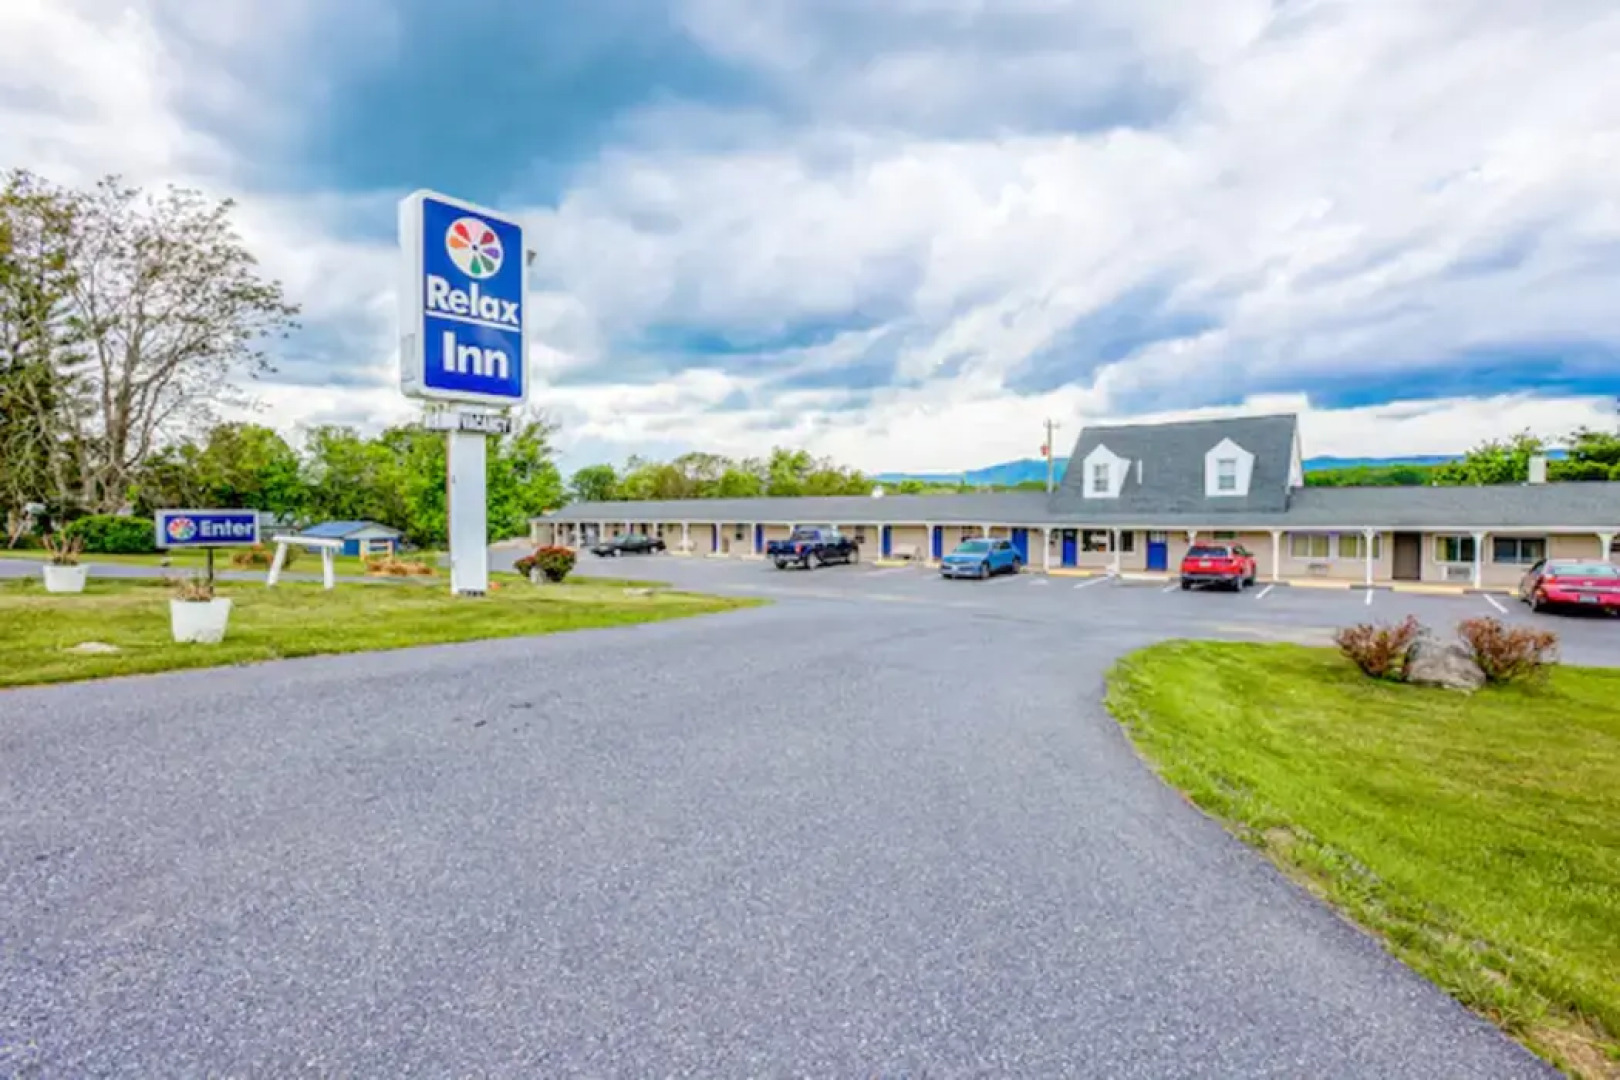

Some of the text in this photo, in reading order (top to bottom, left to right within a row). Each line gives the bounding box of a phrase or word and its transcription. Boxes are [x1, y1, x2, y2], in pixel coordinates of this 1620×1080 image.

[427, 275, 519, 325] Relax
[443, 331, 509, 379] Inn
[200, 518, 255, 537] Enter
